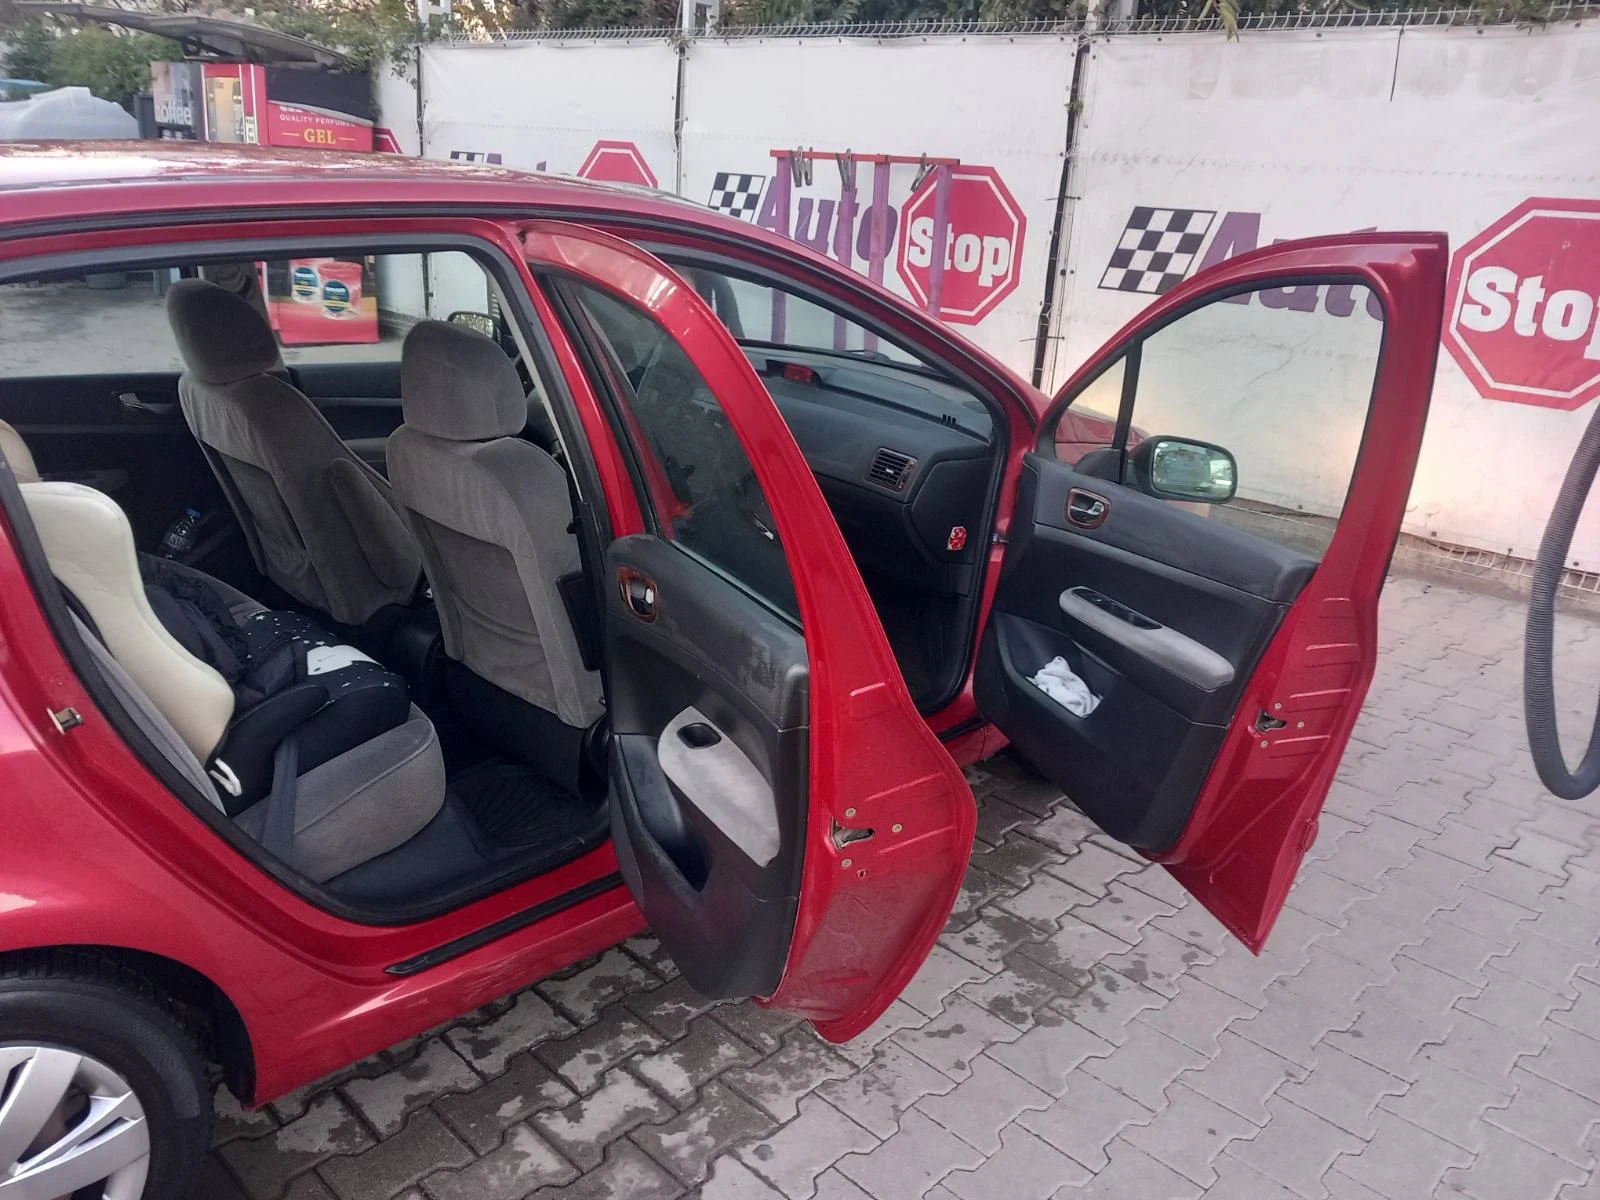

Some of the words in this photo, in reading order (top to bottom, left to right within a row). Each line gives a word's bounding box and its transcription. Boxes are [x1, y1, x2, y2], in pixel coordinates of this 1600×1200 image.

[280, 113, 313, 124] QUALITY
[303, 128, 336, 145] GEL
[1459, 265, 1600, 361] Sto
